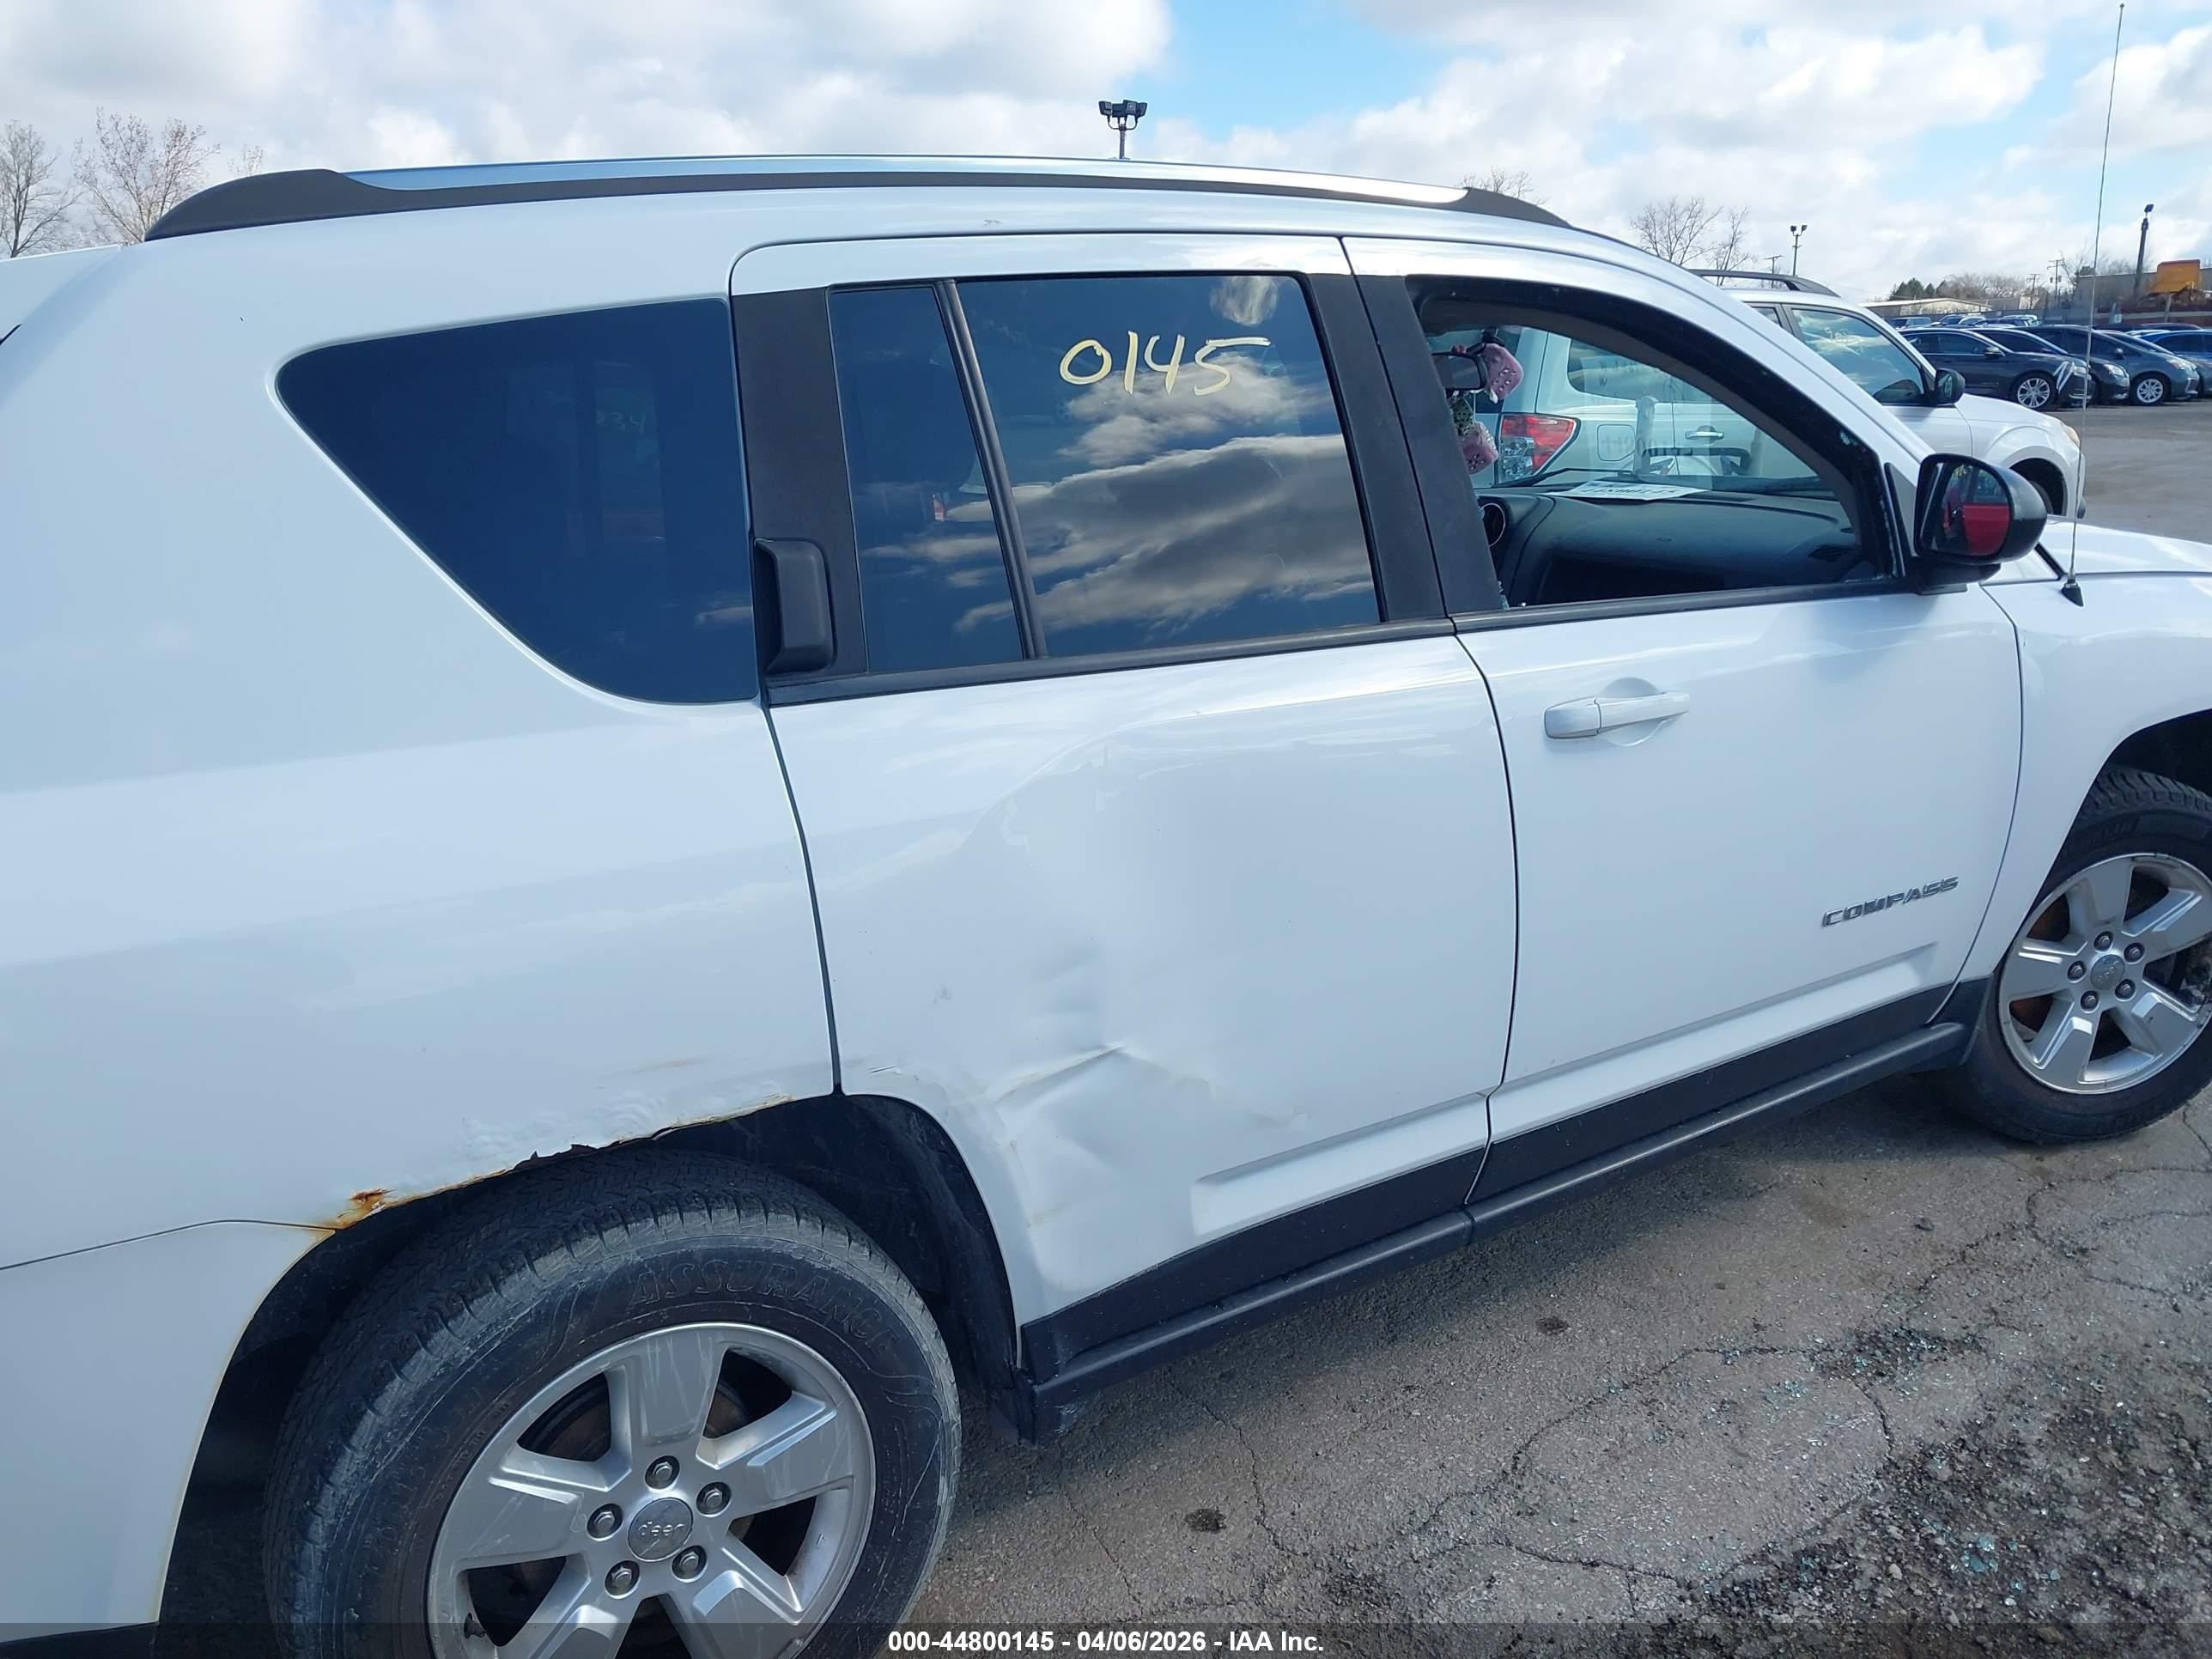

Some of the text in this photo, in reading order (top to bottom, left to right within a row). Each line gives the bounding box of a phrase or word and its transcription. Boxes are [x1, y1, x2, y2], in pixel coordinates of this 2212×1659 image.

[1059, 331, 1271, 395] 0145
[1821, 876, 1959, 927] COMPASS
[625, 1258, 901, 1354] ASSURANCE
